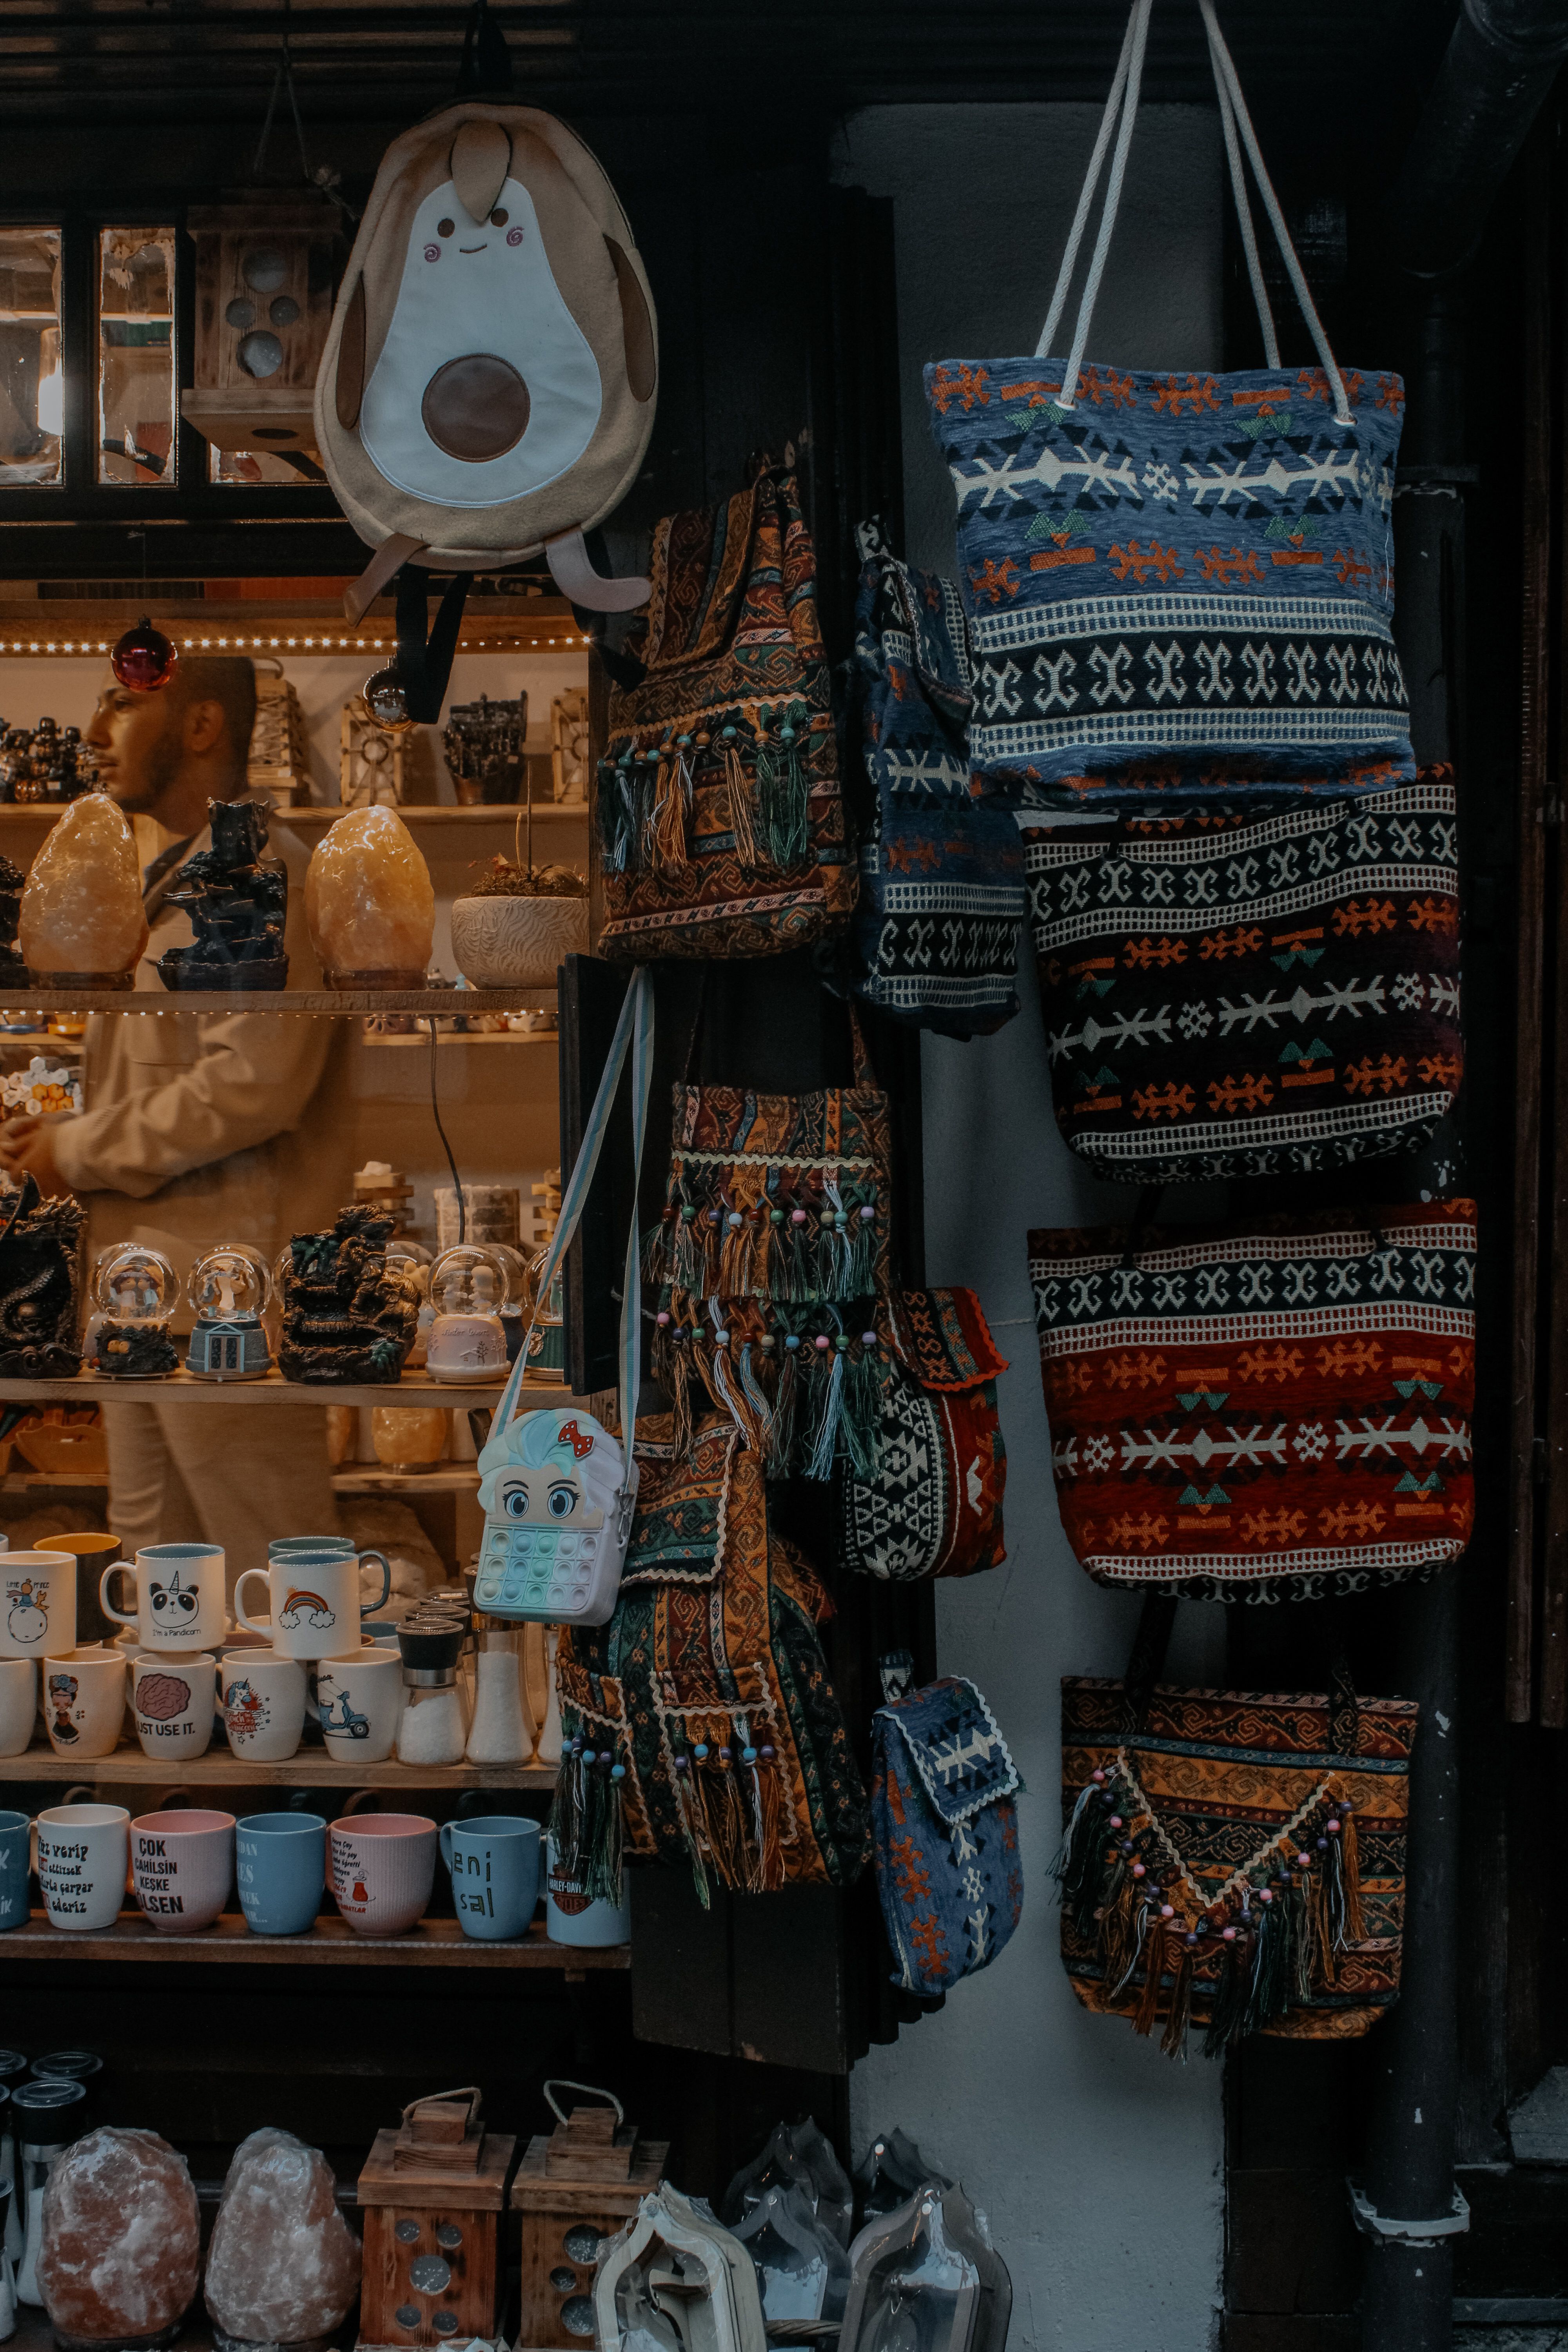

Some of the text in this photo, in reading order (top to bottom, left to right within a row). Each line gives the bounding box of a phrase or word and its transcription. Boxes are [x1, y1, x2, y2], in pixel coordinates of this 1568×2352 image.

[156, 1724, 180, 1736] USE
[183, 1722, 195, 1735] IT.
[53, 1844, 88, 1861] verip
[140, 1837, 166, 1857] ÇOK
[135, 1857, 178, 1874] CAHİLSİN
[60, 1883, 93, 1895] çarpar
[140, 1876, 170, 1892] KEŞKE
[53, 1898, 87, 1913] ederiz
[136, 1887, 184, 1913] ÖLSEN
